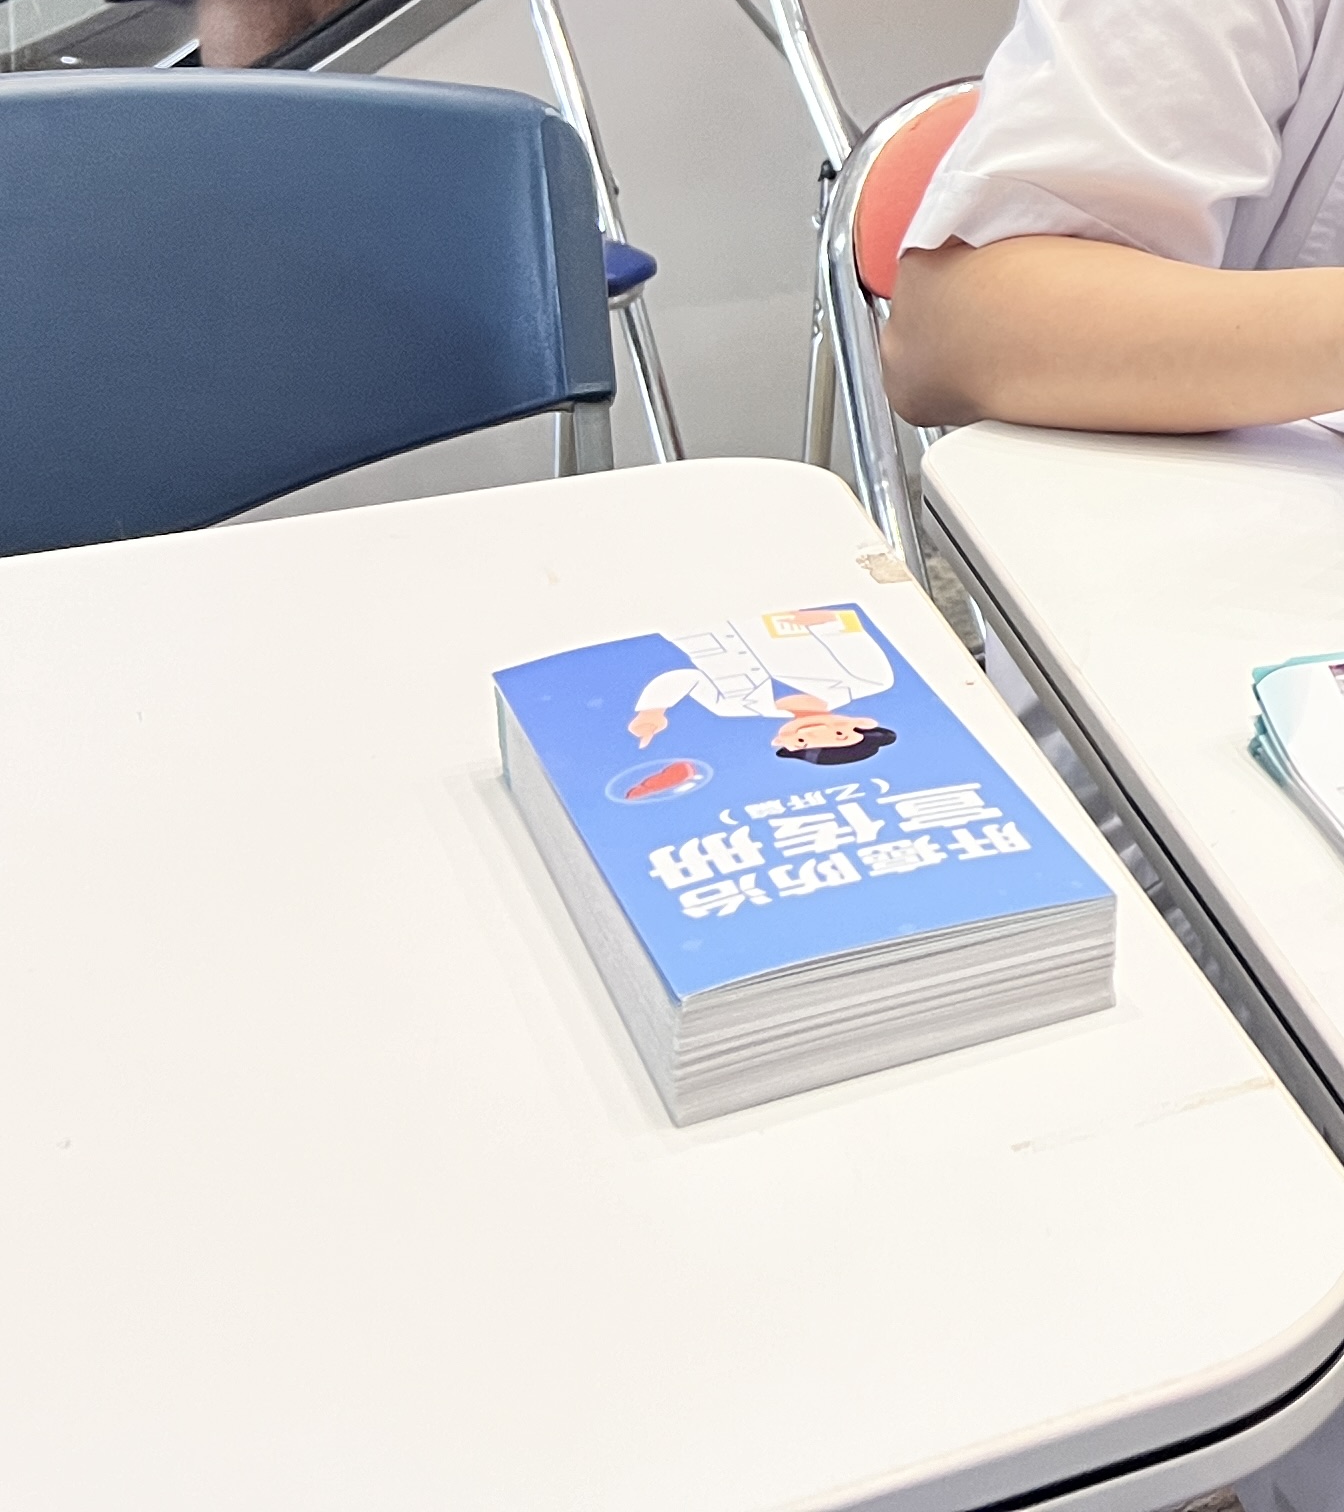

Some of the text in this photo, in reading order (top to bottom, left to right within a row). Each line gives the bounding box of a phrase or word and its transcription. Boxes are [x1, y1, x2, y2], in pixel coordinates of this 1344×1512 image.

[649, 782, 1003, 890] 宣传册
[679, 822, 1032, 919] 肝癌防治
